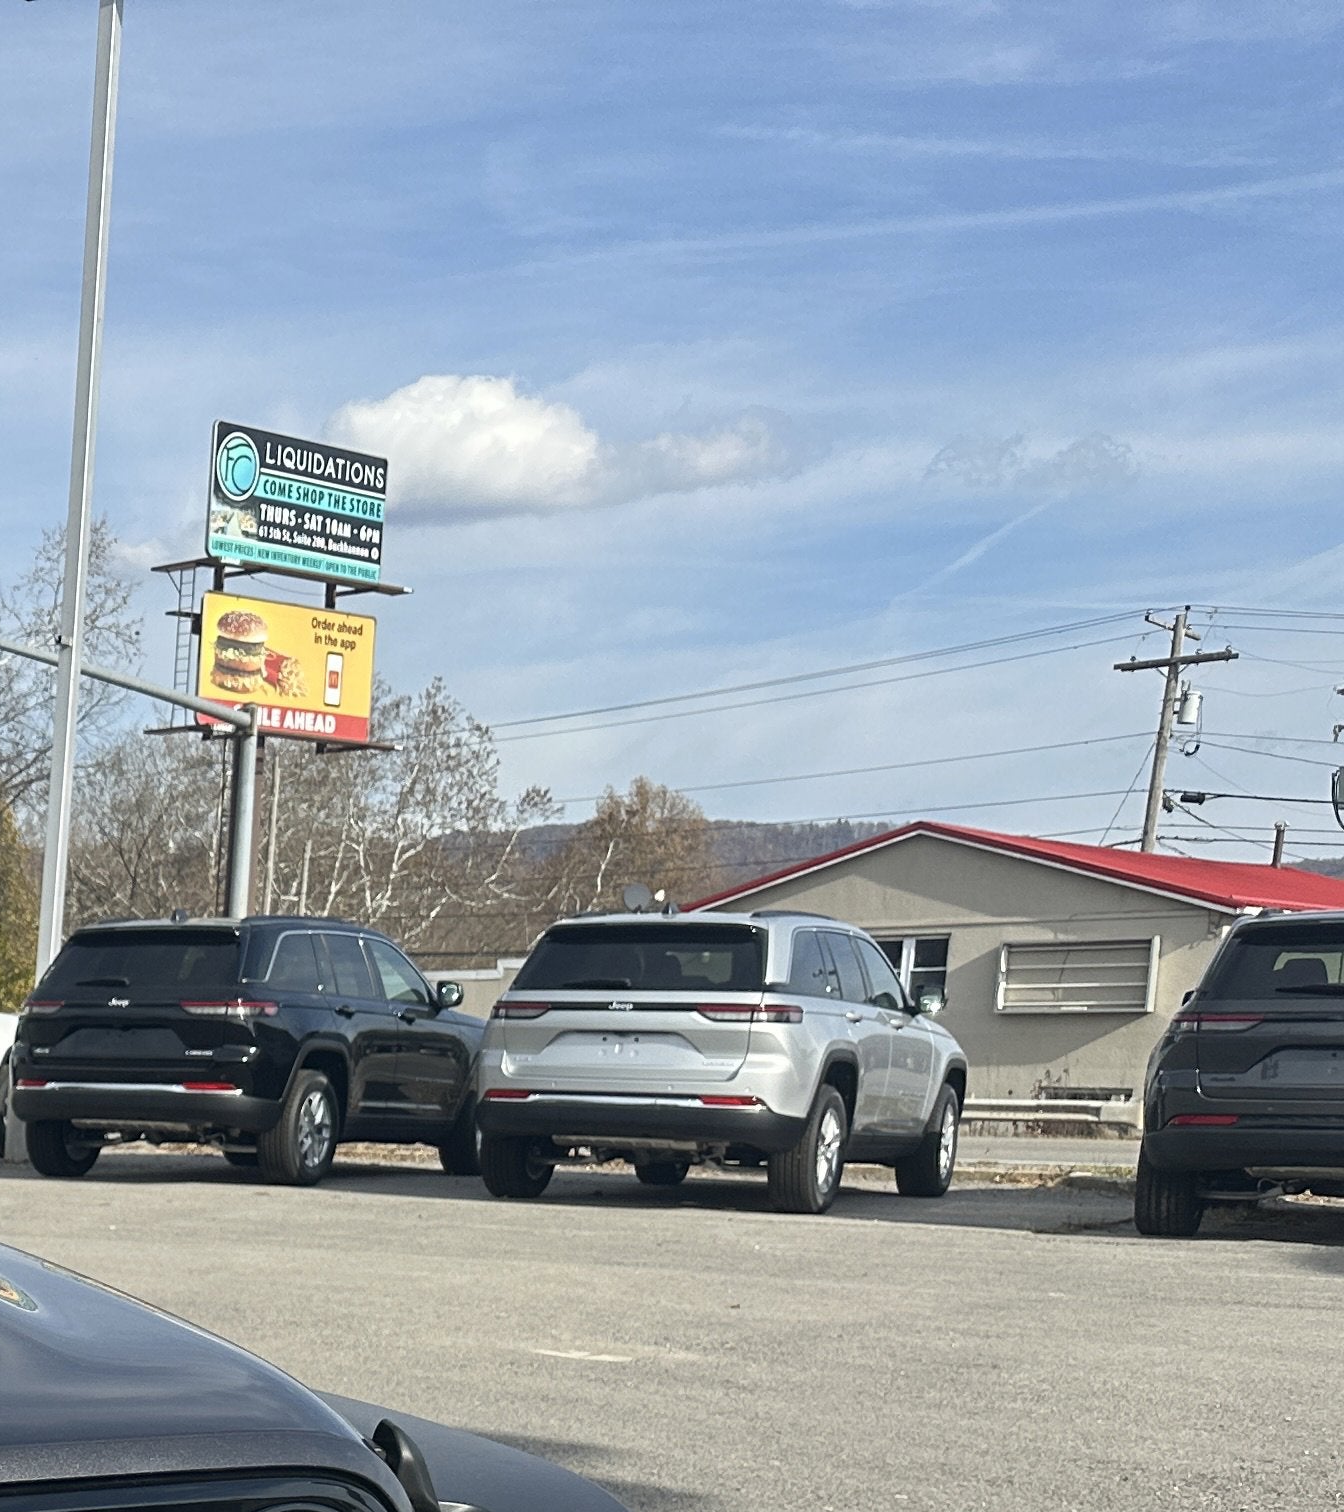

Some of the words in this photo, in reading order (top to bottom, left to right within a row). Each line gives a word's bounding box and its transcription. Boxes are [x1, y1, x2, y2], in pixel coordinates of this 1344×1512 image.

[265, 442, 385, 488] LIQUIDATIONS
[263, 478, 293, 499] COME
[296, 485, 324, 507] SHOP
[328, 491, 347, 512] THE
[349, 497, 382, 519] STORE
[258, 525, 268, 537] 61
[259, 503, 296, 527] THURS
[303, 512, 323, 532] SAT
[325, 517, 352, 538] 10AM
[359, 525, 380, 544] 6PM
[312, 616, 335, 631] Order
[337, 621, 363, 636] ahead
[314, 632, 322, 644] in
[324, 634, 338, 647] the
[340, 639, 356, 651] app
[283, 709, 336, 733] AHEAD
[609, 1001, 633, 1011] Jeep
